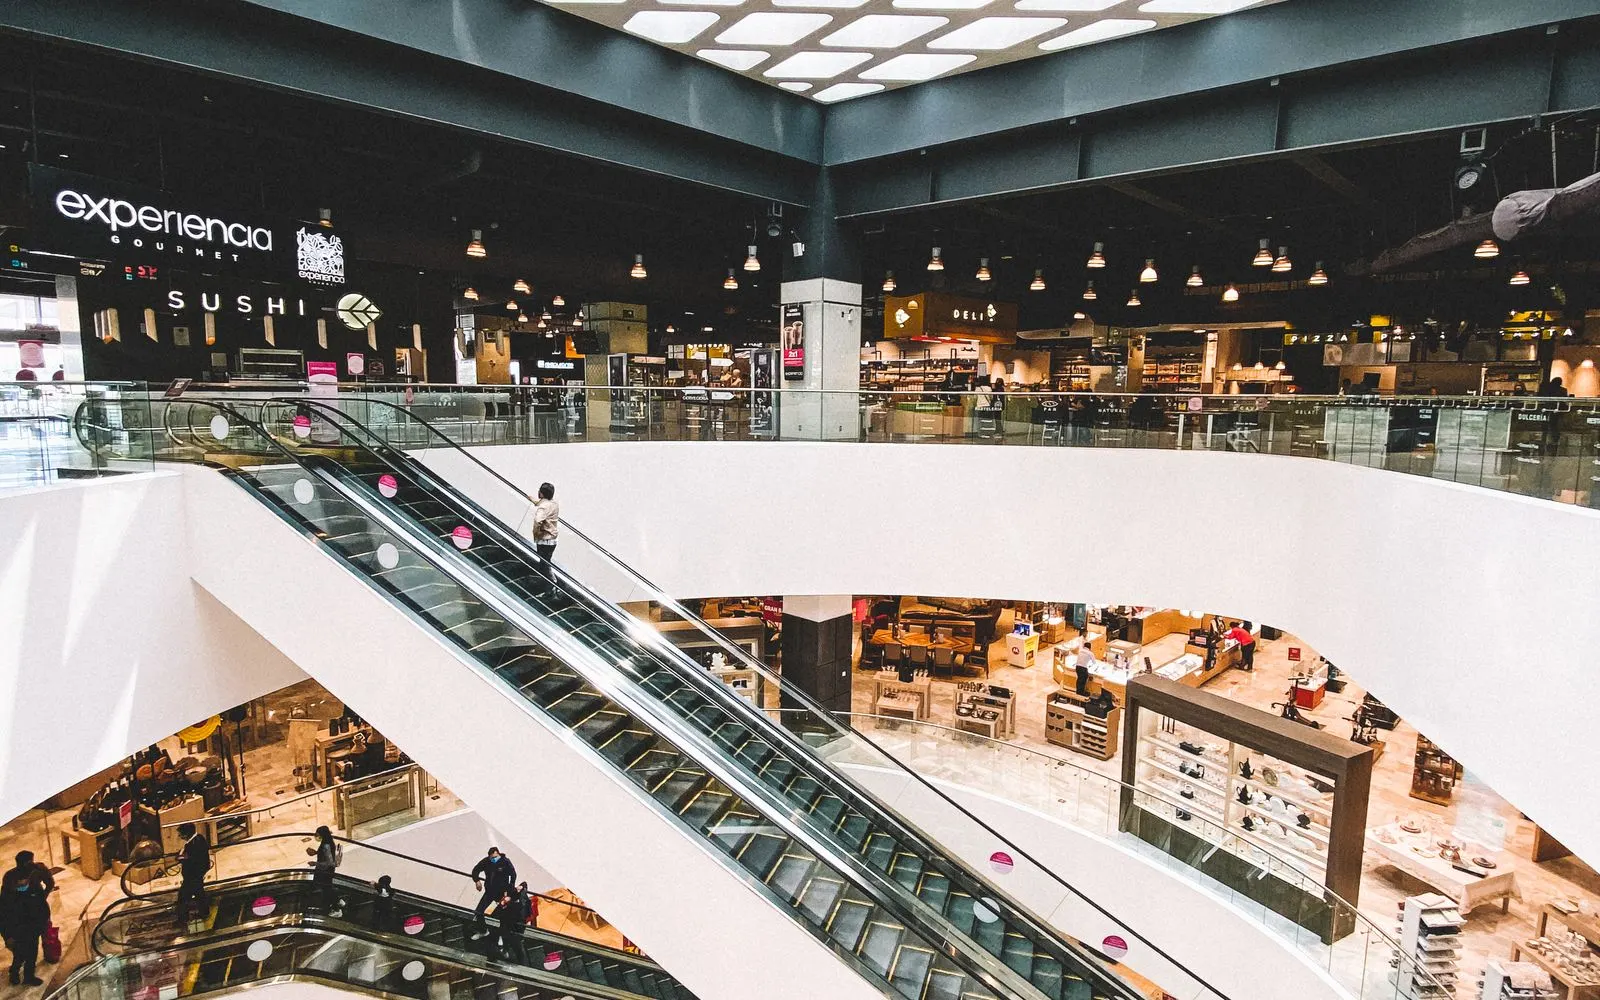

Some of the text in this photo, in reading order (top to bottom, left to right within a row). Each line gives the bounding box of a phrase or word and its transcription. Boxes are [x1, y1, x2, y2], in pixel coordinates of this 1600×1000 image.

[56, 189, 273, 252] experiencia
[111, 235, 239, 262] GOURMET
[168, 290, 304, 316] SUSHI
[953, 309, 984, 321] DELI
[1290, 334, 1348, 343] PIZZA
